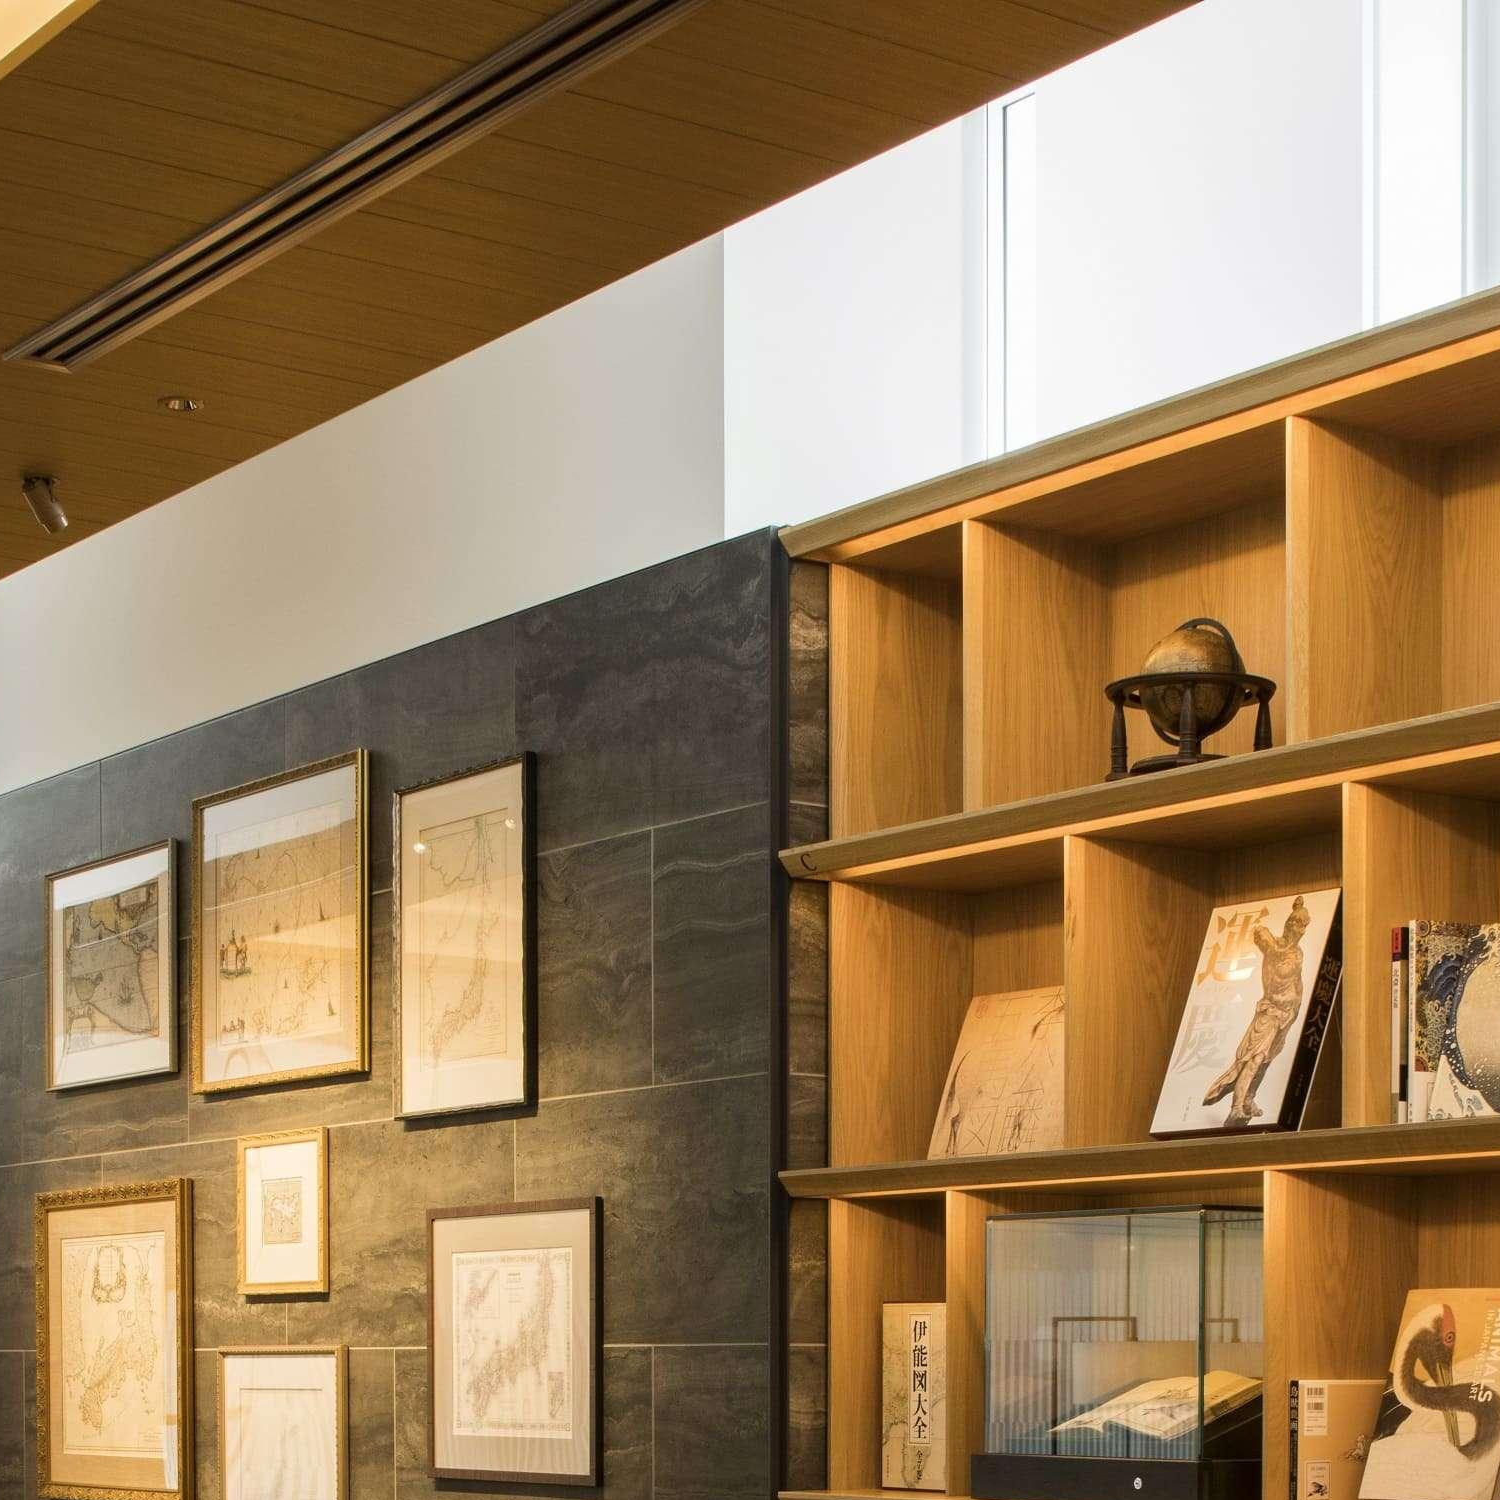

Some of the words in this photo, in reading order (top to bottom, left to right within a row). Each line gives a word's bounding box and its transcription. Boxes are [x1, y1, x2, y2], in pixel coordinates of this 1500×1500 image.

[912, 1320, 928, 1439] 伊能図大全
[1469, 1380, 1480, 1400] ART
